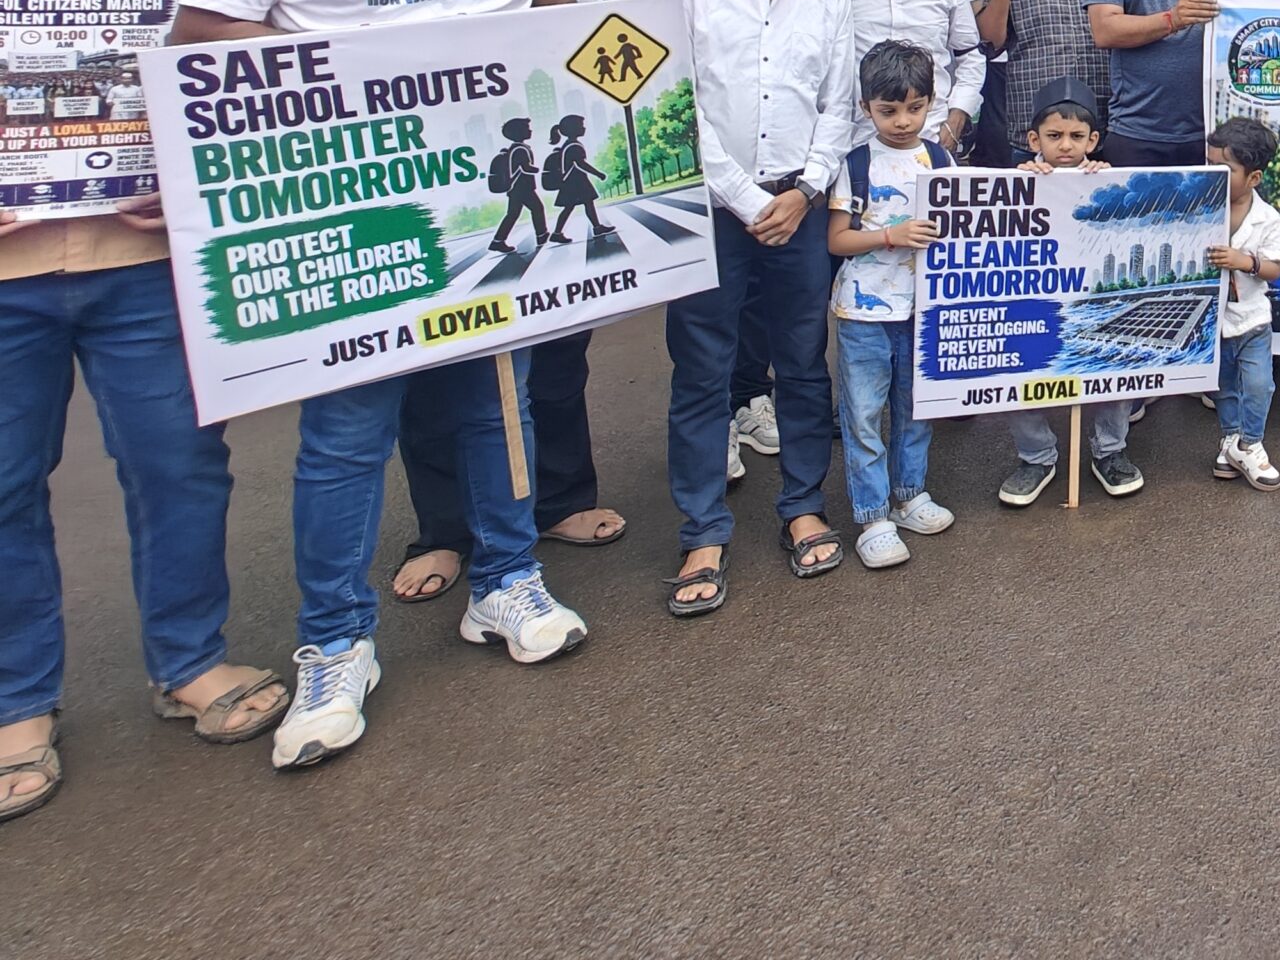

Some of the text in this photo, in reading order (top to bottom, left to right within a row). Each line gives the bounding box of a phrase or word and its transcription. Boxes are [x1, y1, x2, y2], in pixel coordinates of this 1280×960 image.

[0, 12, 141, 24] SILENT PROTEST
[46, 30, 87, 40] 10:00
[177, 40, 335, 97] SAFE
[184, 62, 510, 140] SCHOOL ROUTES
[3, 124, 94, 138] JUST A LOYAL
[8, 139, 26, 150] UP
[30, 137, 58, 148] FOR
[61, 134, 98, 146] YOUR
[192, 114, 427, 186] BRIGHTER
[199, 146, 486, 229] TOMORROWS.
[927, 176, 1036, 208] CLEAN
[928, 208, 1050, 239] DRAINS
[227, 223, 354, 273] PROTECT
[926, 239, 1059, 270] CLEANER
[232, 238, 428, 300] OUR CHILDREN.
[925, 267, 1089, 300] TOMORROW.
[236, 262, 434, 329] ON THE ROADS.
[323, 269, 638, 367] JUST A LOYAL TAX PAYER
[938, 307, 1007, 324] PREVENT
[938, 320, 1050, 340] WATERLOGGING.
[938, 339, 1006, 356] PREVENT
[938, 353, 1024, 373] TRAGEDIES.
[962, 373, 1165, 406] JUST A LOYAL TAX PAYER
